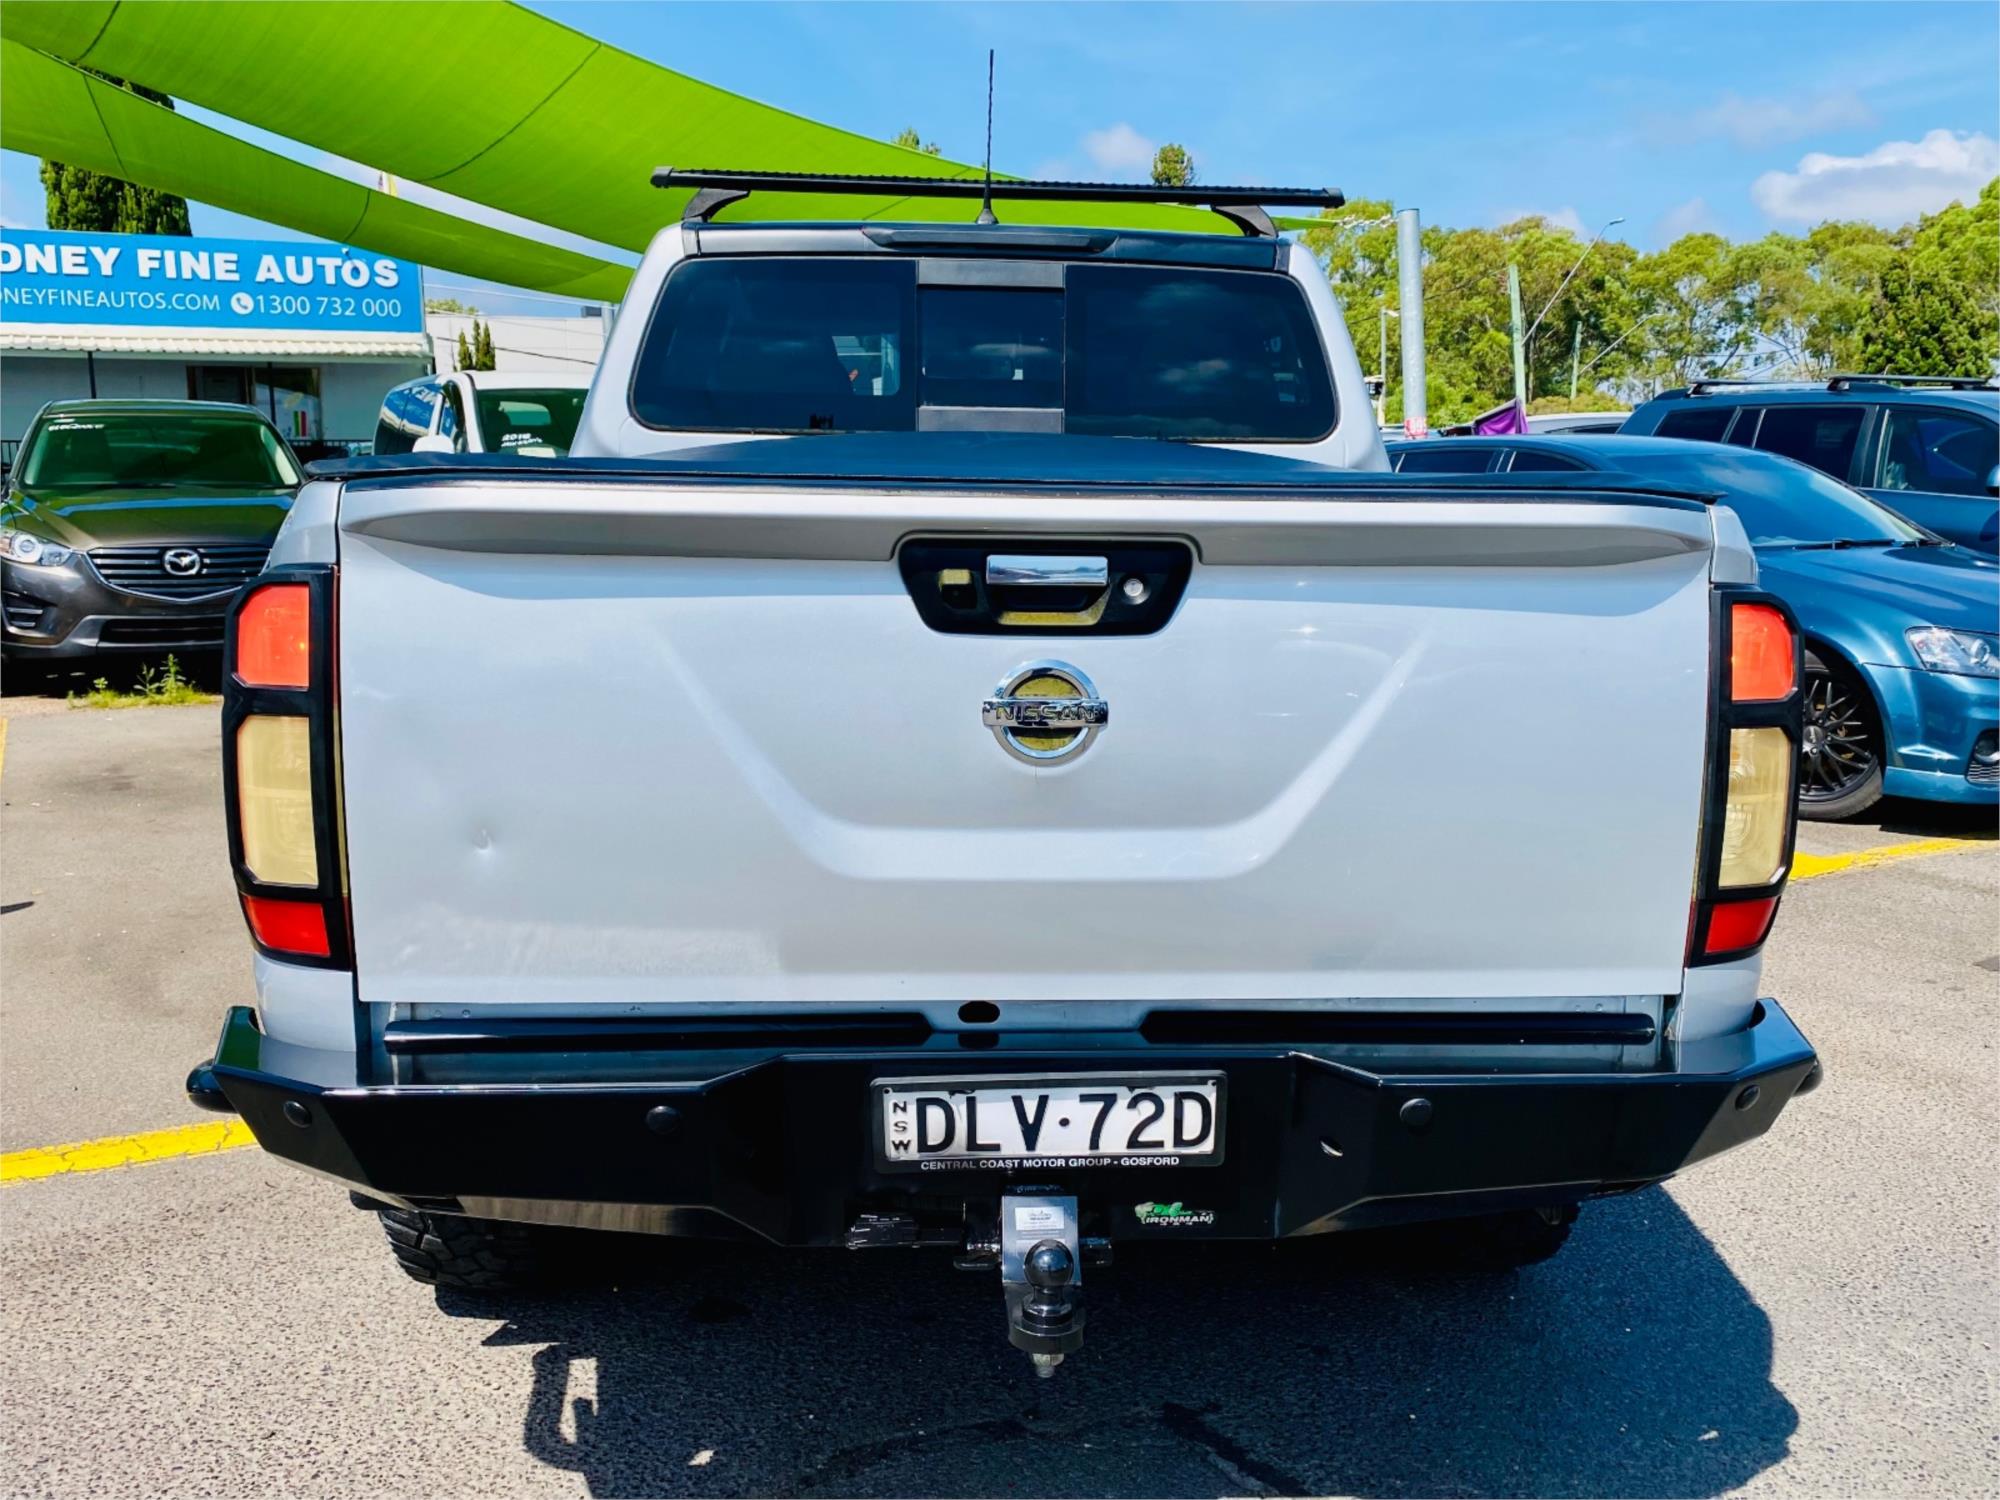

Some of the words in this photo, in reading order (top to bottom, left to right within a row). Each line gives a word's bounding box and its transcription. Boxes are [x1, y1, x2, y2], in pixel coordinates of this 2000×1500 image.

[137, 249, 240, 281] FINE
[255, 254, 399, 288] AUTOS
[0, 288, 220, 311] NEYFINEAUTOS.COM
[256, 295, 311, 315] 1300
[316, 297, 356, 316] 732
[362, 299, 401, 317] 000
[996, 705, 1096, 721] NISSAN
[892, 1101, 911, 1152] NSW
[921, 1161, 976, 1170] CENTRAL
[980, 1160, 1020, 1169] COAST
[1023, 1159, 1066, 1168] MOTOR
[1068, 1158, 1111, 1167] GROUP
[1120, 1156, 1179, 1166] GOSFORD
[1146, 1215, 1209, 1223] IRONMAN
